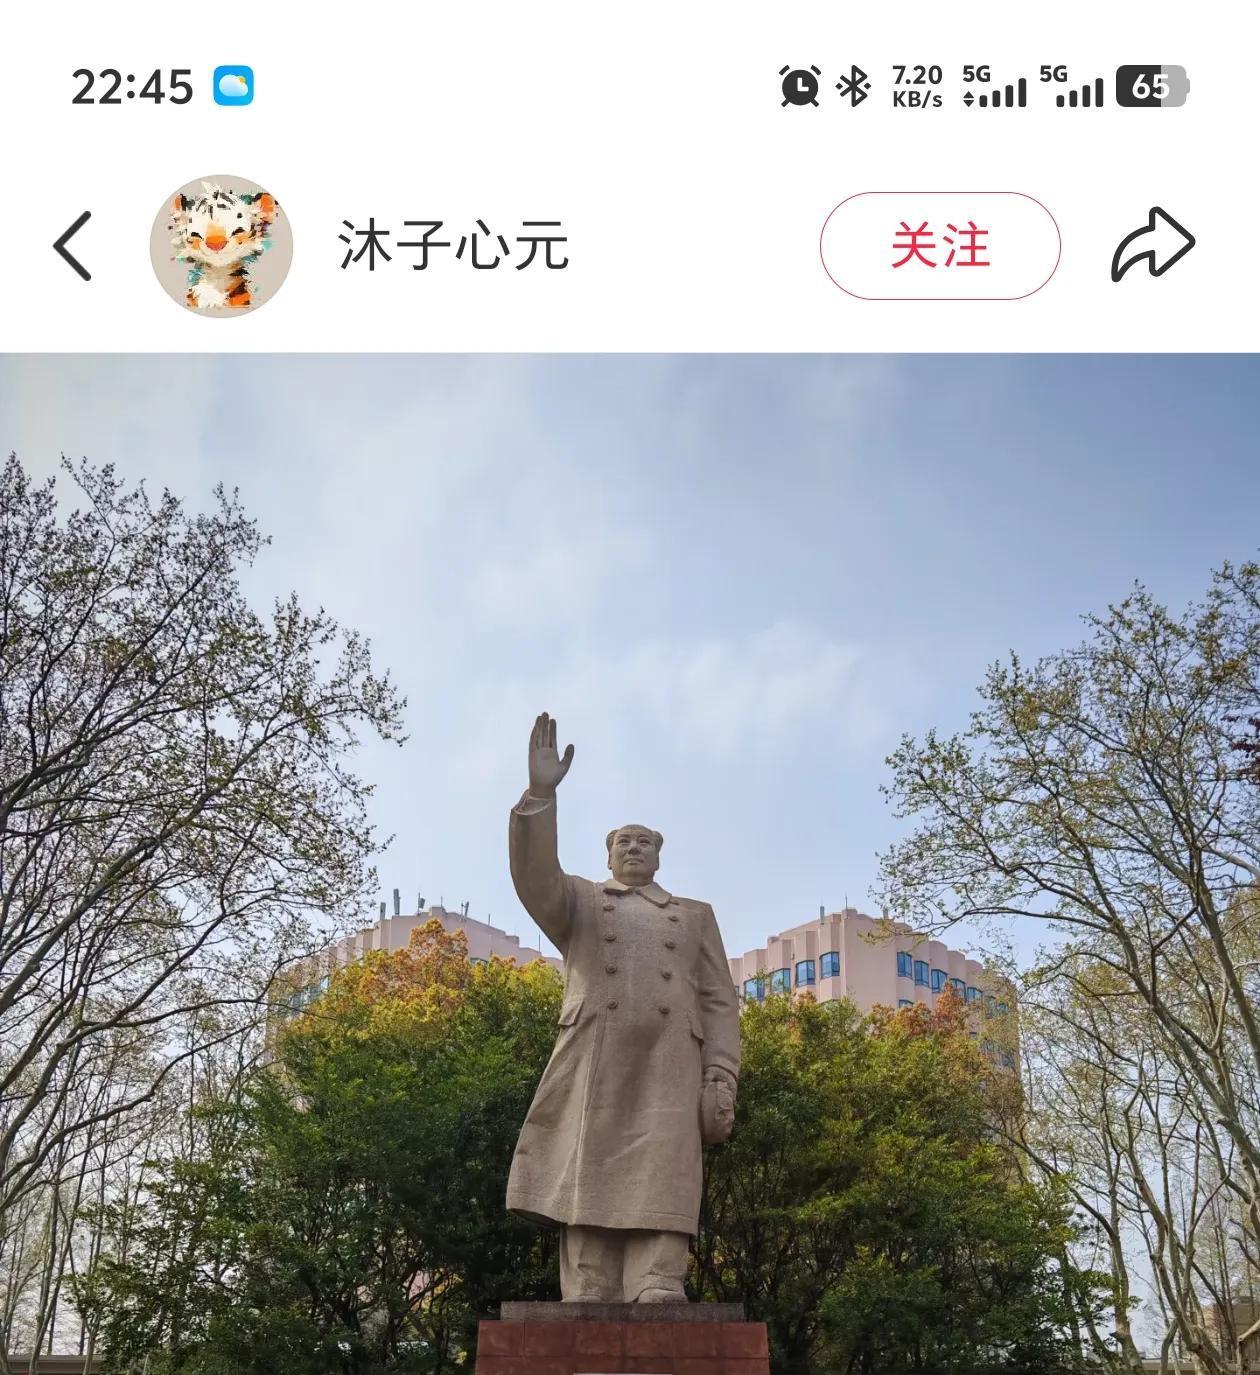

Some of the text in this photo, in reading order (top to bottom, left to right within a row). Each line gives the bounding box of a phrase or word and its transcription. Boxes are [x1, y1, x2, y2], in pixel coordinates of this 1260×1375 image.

[892, 65, 942, 84] 7.20
[962, 65, 991, 82] 5G
[1039, 65, 1068, 82] 5G
[72, 69, 193, 104] 22:45
[1132, 73, 1170, 99] 65
[893, 90, 942, 108] KB/s
[337, 217, 570, 272] 沐子心元
[891, 219, 992, 270] 关注
